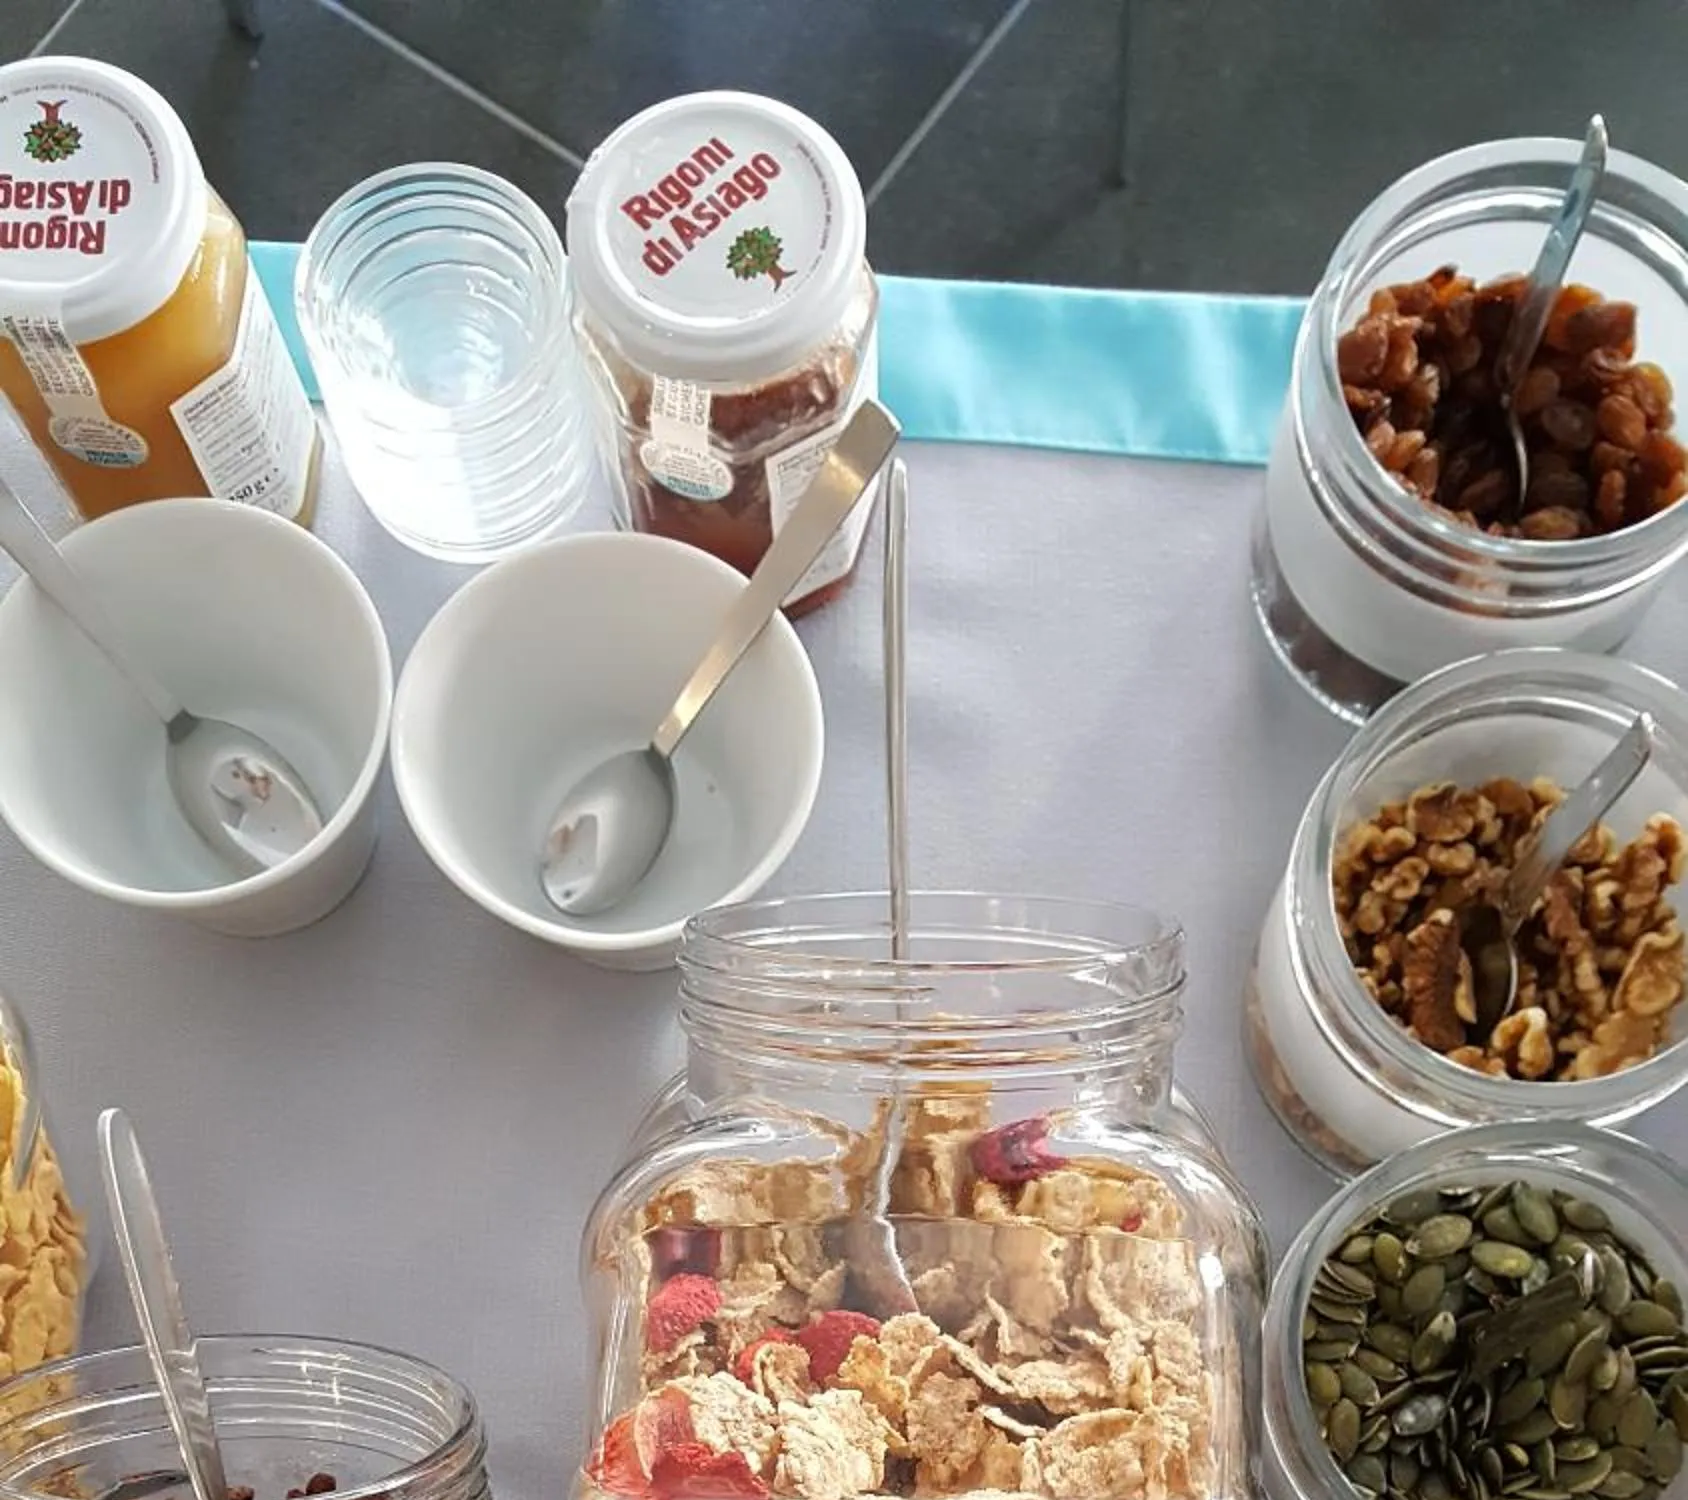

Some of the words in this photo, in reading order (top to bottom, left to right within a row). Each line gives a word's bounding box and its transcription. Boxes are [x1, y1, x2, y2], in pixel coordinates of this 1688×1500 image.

[0, 174, 95, 215] Asiag
[98, 179, 131, 214] di
[620, 137, 735, 231] Rigoni
[0, 214, 106, 255] Rigon
[642, 238, 684, 277] di
[669, 153, 782, 251] Asiago
